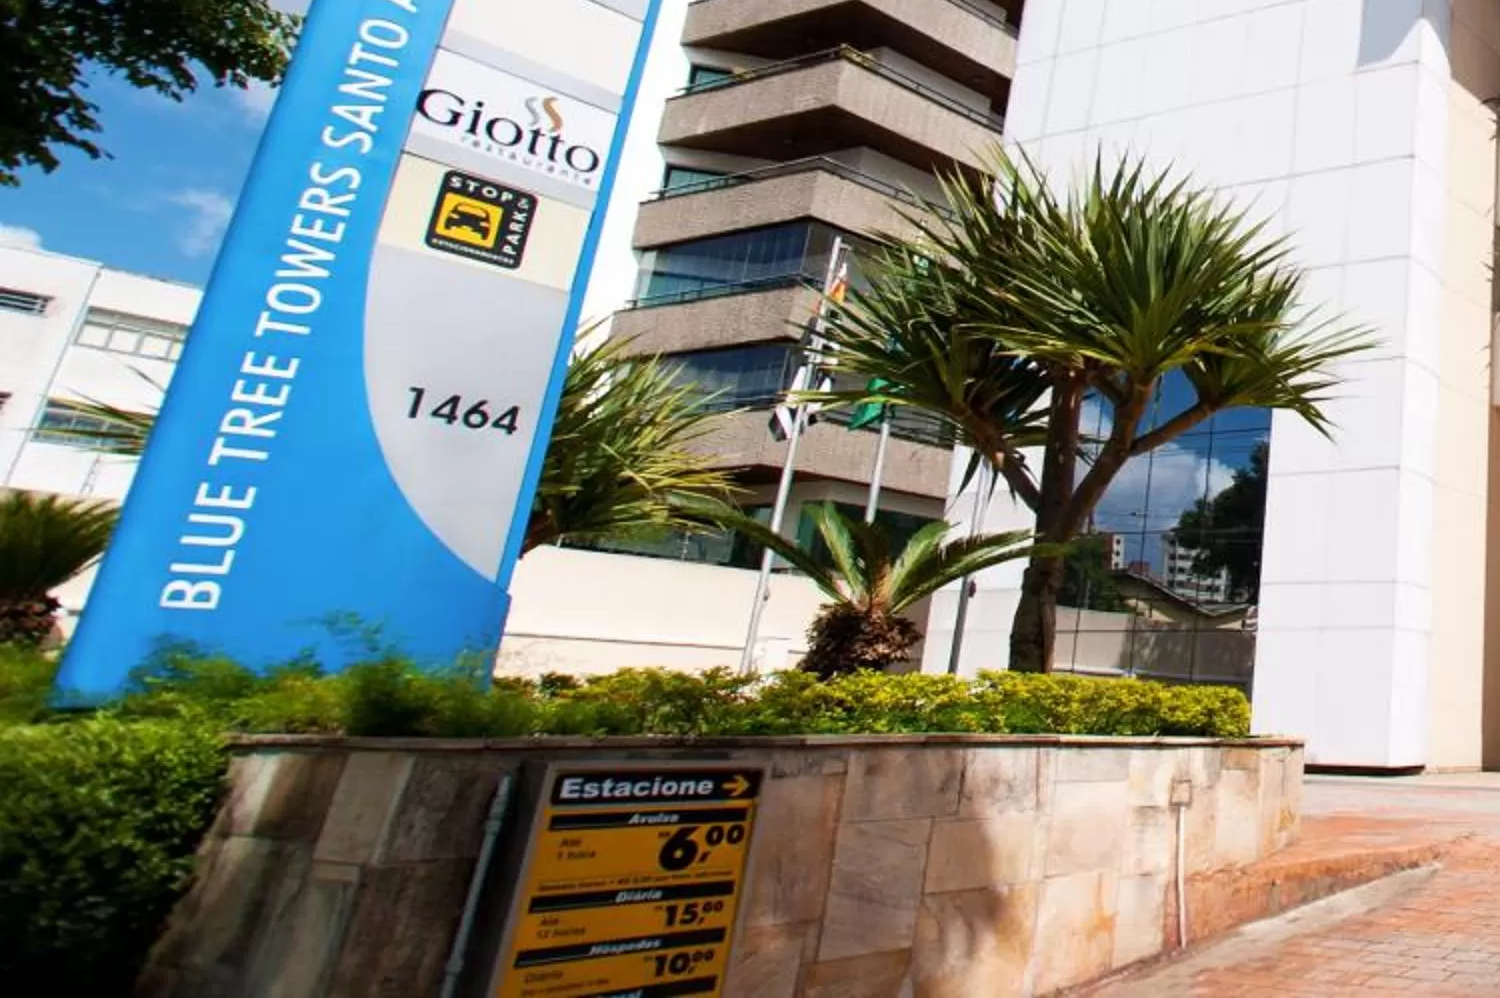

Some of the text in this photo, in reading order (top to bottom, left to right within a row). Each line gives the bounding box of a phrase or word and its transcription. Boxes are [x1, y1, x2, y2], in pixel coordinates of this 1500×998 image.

[321, 18, 409, 155] SANTO
[416, 88, 600, 174] Giotto
[449, 175, 513, 202] STOP
[254, 162, 361, 337] TOWERS
[502, 210, 528, 255] PARK
[207, 351, 301, 466] TREE
[408, 386, 520, 435] 1464
[159, 482, 257, 610] BLUE
[559, 776, 714, 800] Estacione
